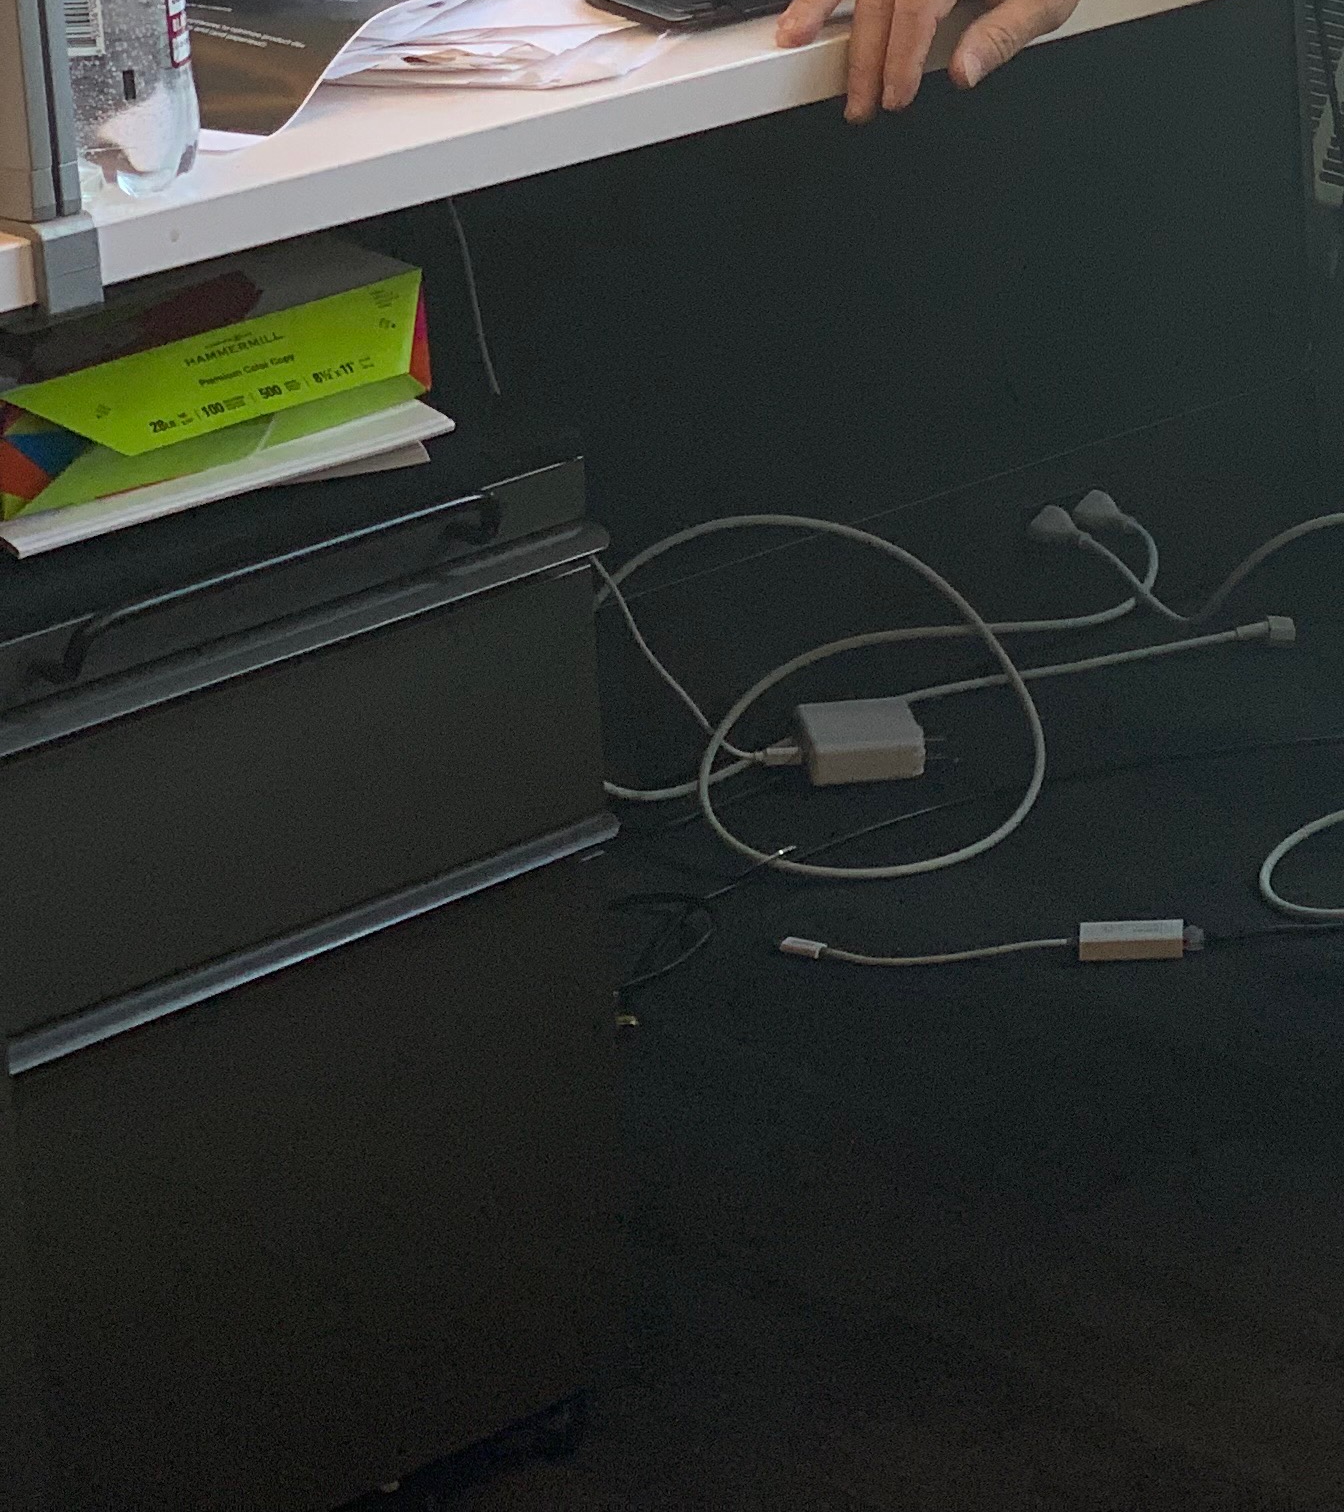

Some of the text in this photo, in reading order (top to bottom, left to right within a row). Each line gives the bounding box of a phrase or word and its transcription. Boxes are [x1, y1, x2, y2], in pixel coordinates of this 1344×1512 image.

[184, 331, 285, 367] HAMMERMILL
[201, 402, 225, 418] 100
[259, 385, 283, 400] 500
